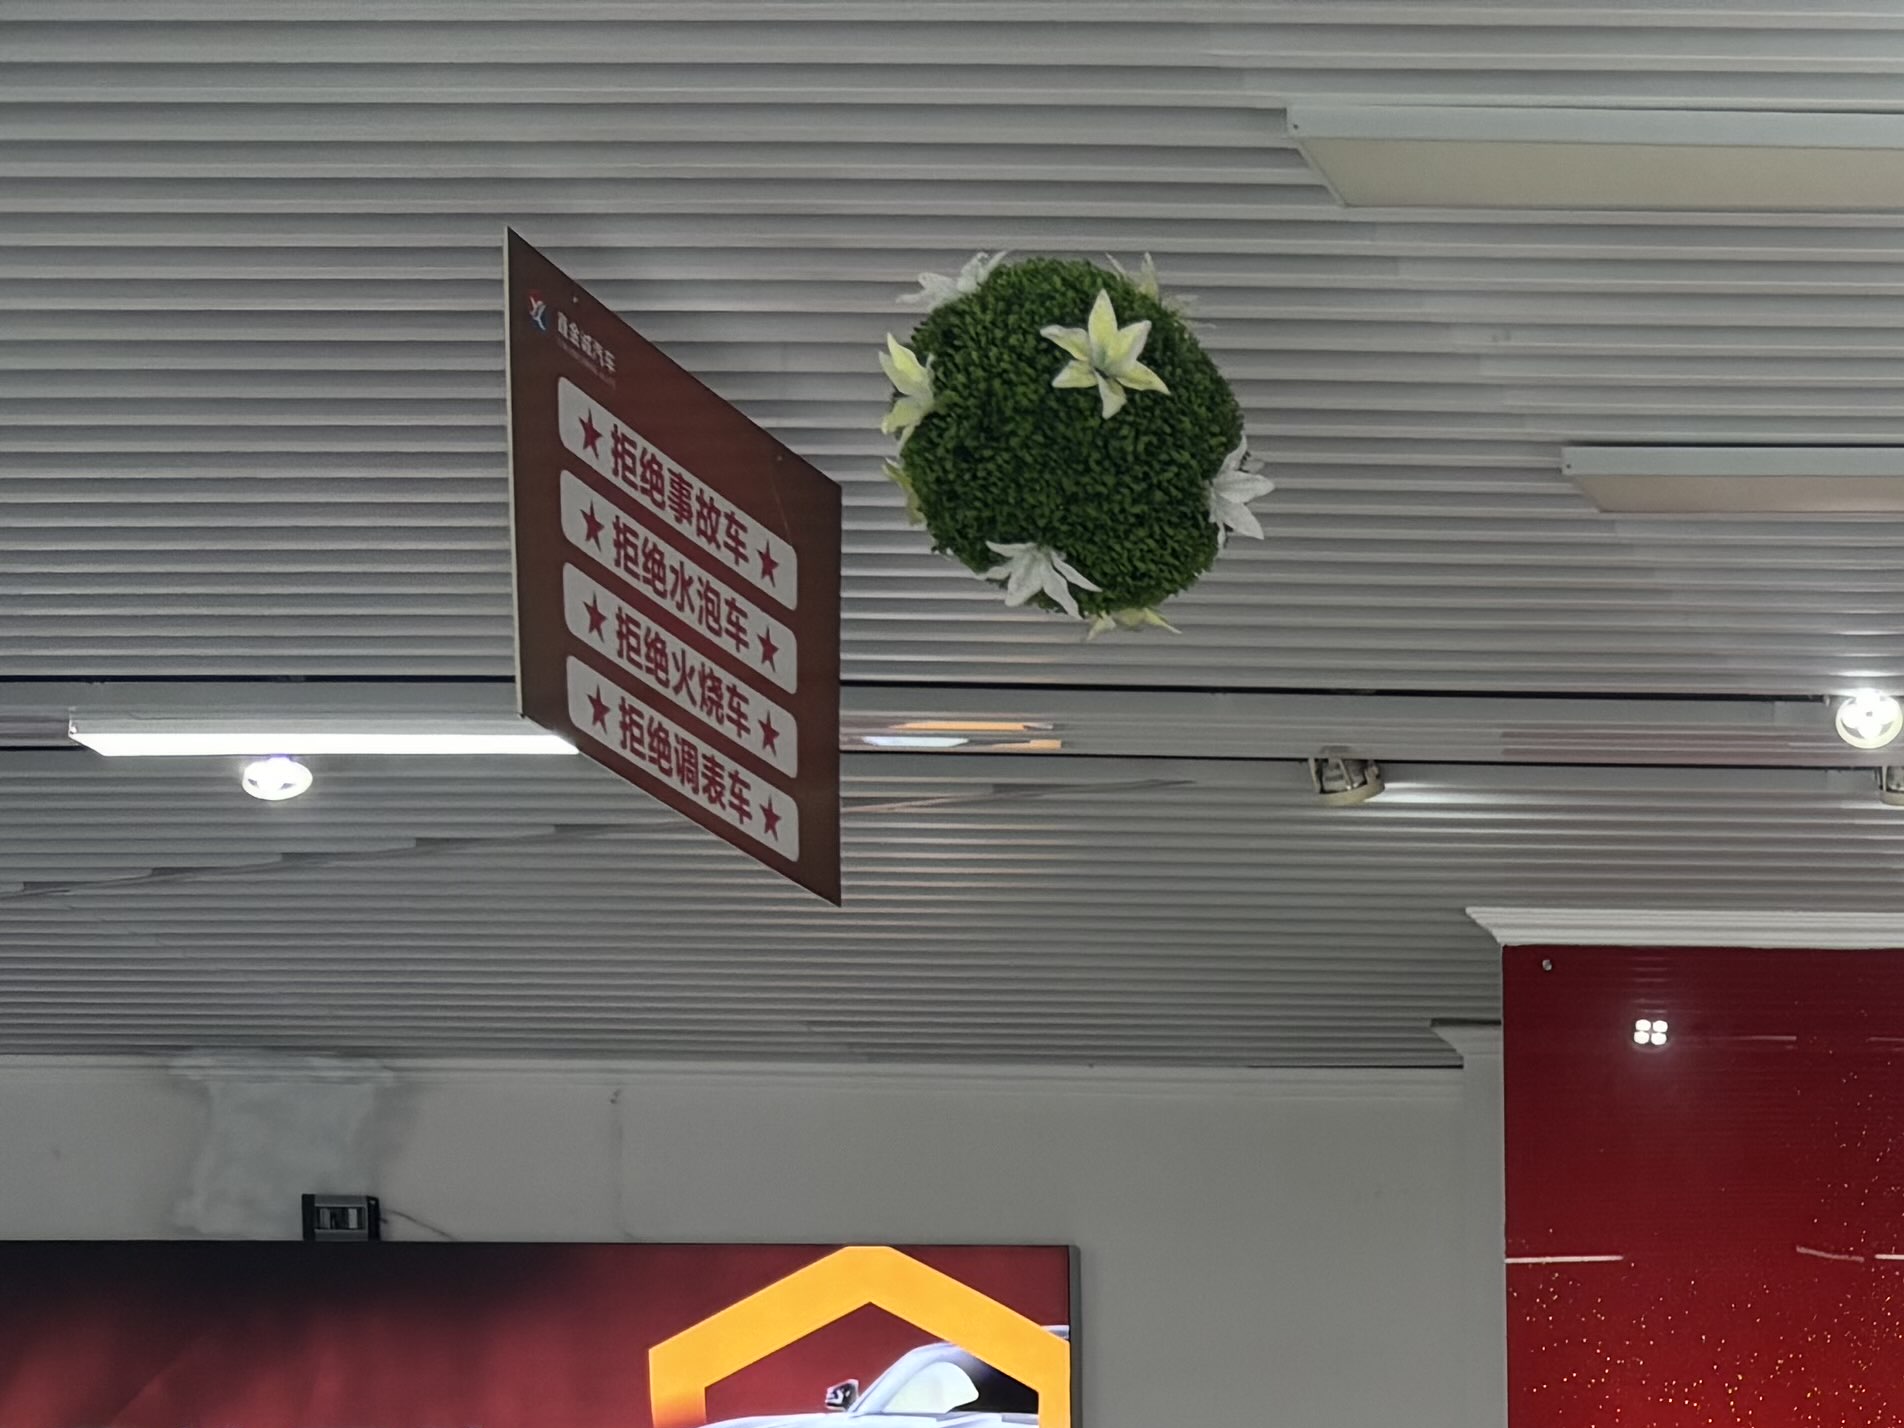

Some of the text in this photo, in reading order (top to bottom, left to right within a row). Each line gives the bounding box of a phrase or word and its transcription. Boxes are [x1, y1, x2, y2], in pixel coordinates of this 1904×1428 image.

[610, 423, 750, 567] 拒绝事故车
[612, 515, 750, 653] 拒绝水泡车
[615, 606, 751, 739] 拒绝火烧车
[618, 695, 753, 826] 拒绝调表车
